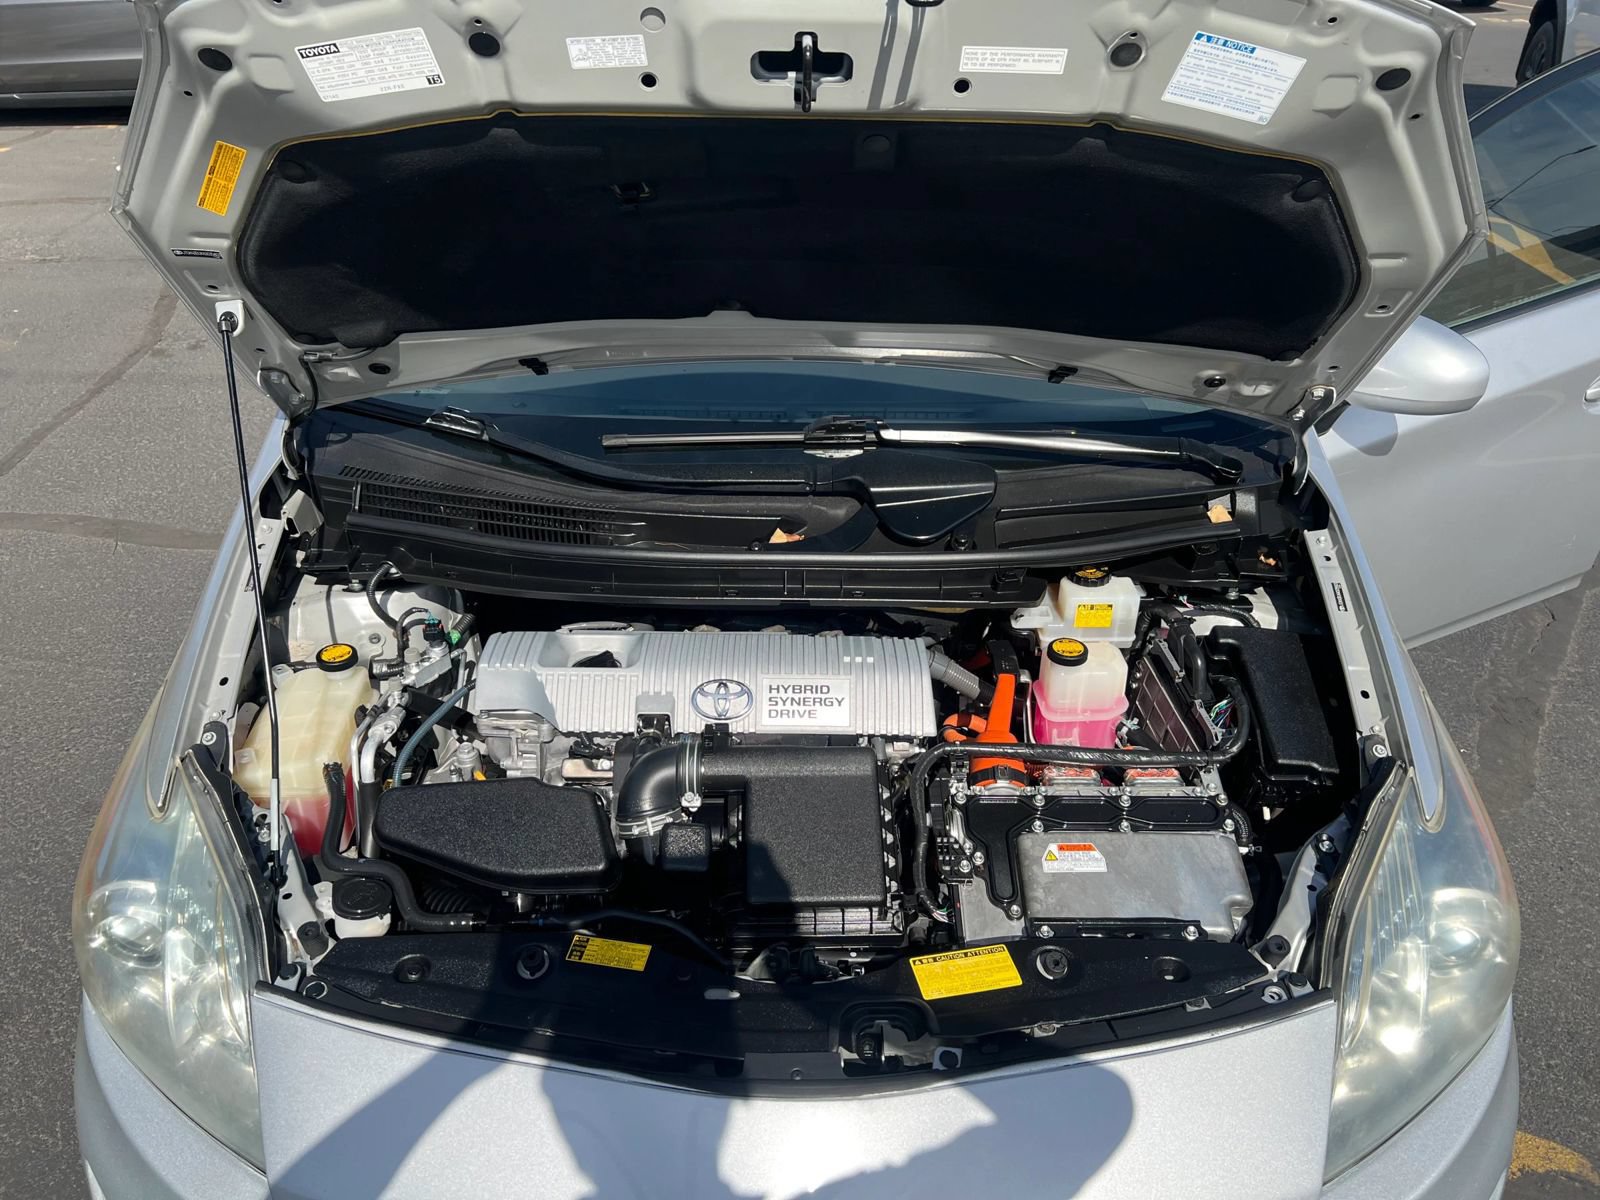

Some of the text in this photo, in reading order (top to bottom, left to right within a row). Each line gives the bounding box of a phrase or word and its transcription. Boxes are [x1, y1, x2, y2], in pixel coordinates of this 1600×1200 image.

[300, 44, 339, 58] TOYOTA
[1225, 40, 1253, 54] NOTICE
[427, 75, 441, 85] T5
[768, 684, 830, 695] HYBRID
[768, 697, 845, 707] SYNERGY
[768, 709, 818, 719] DRIVE
[936, 953, 966, 962] CAUTION
[967, 947, 1004, 957] ATTENTION
